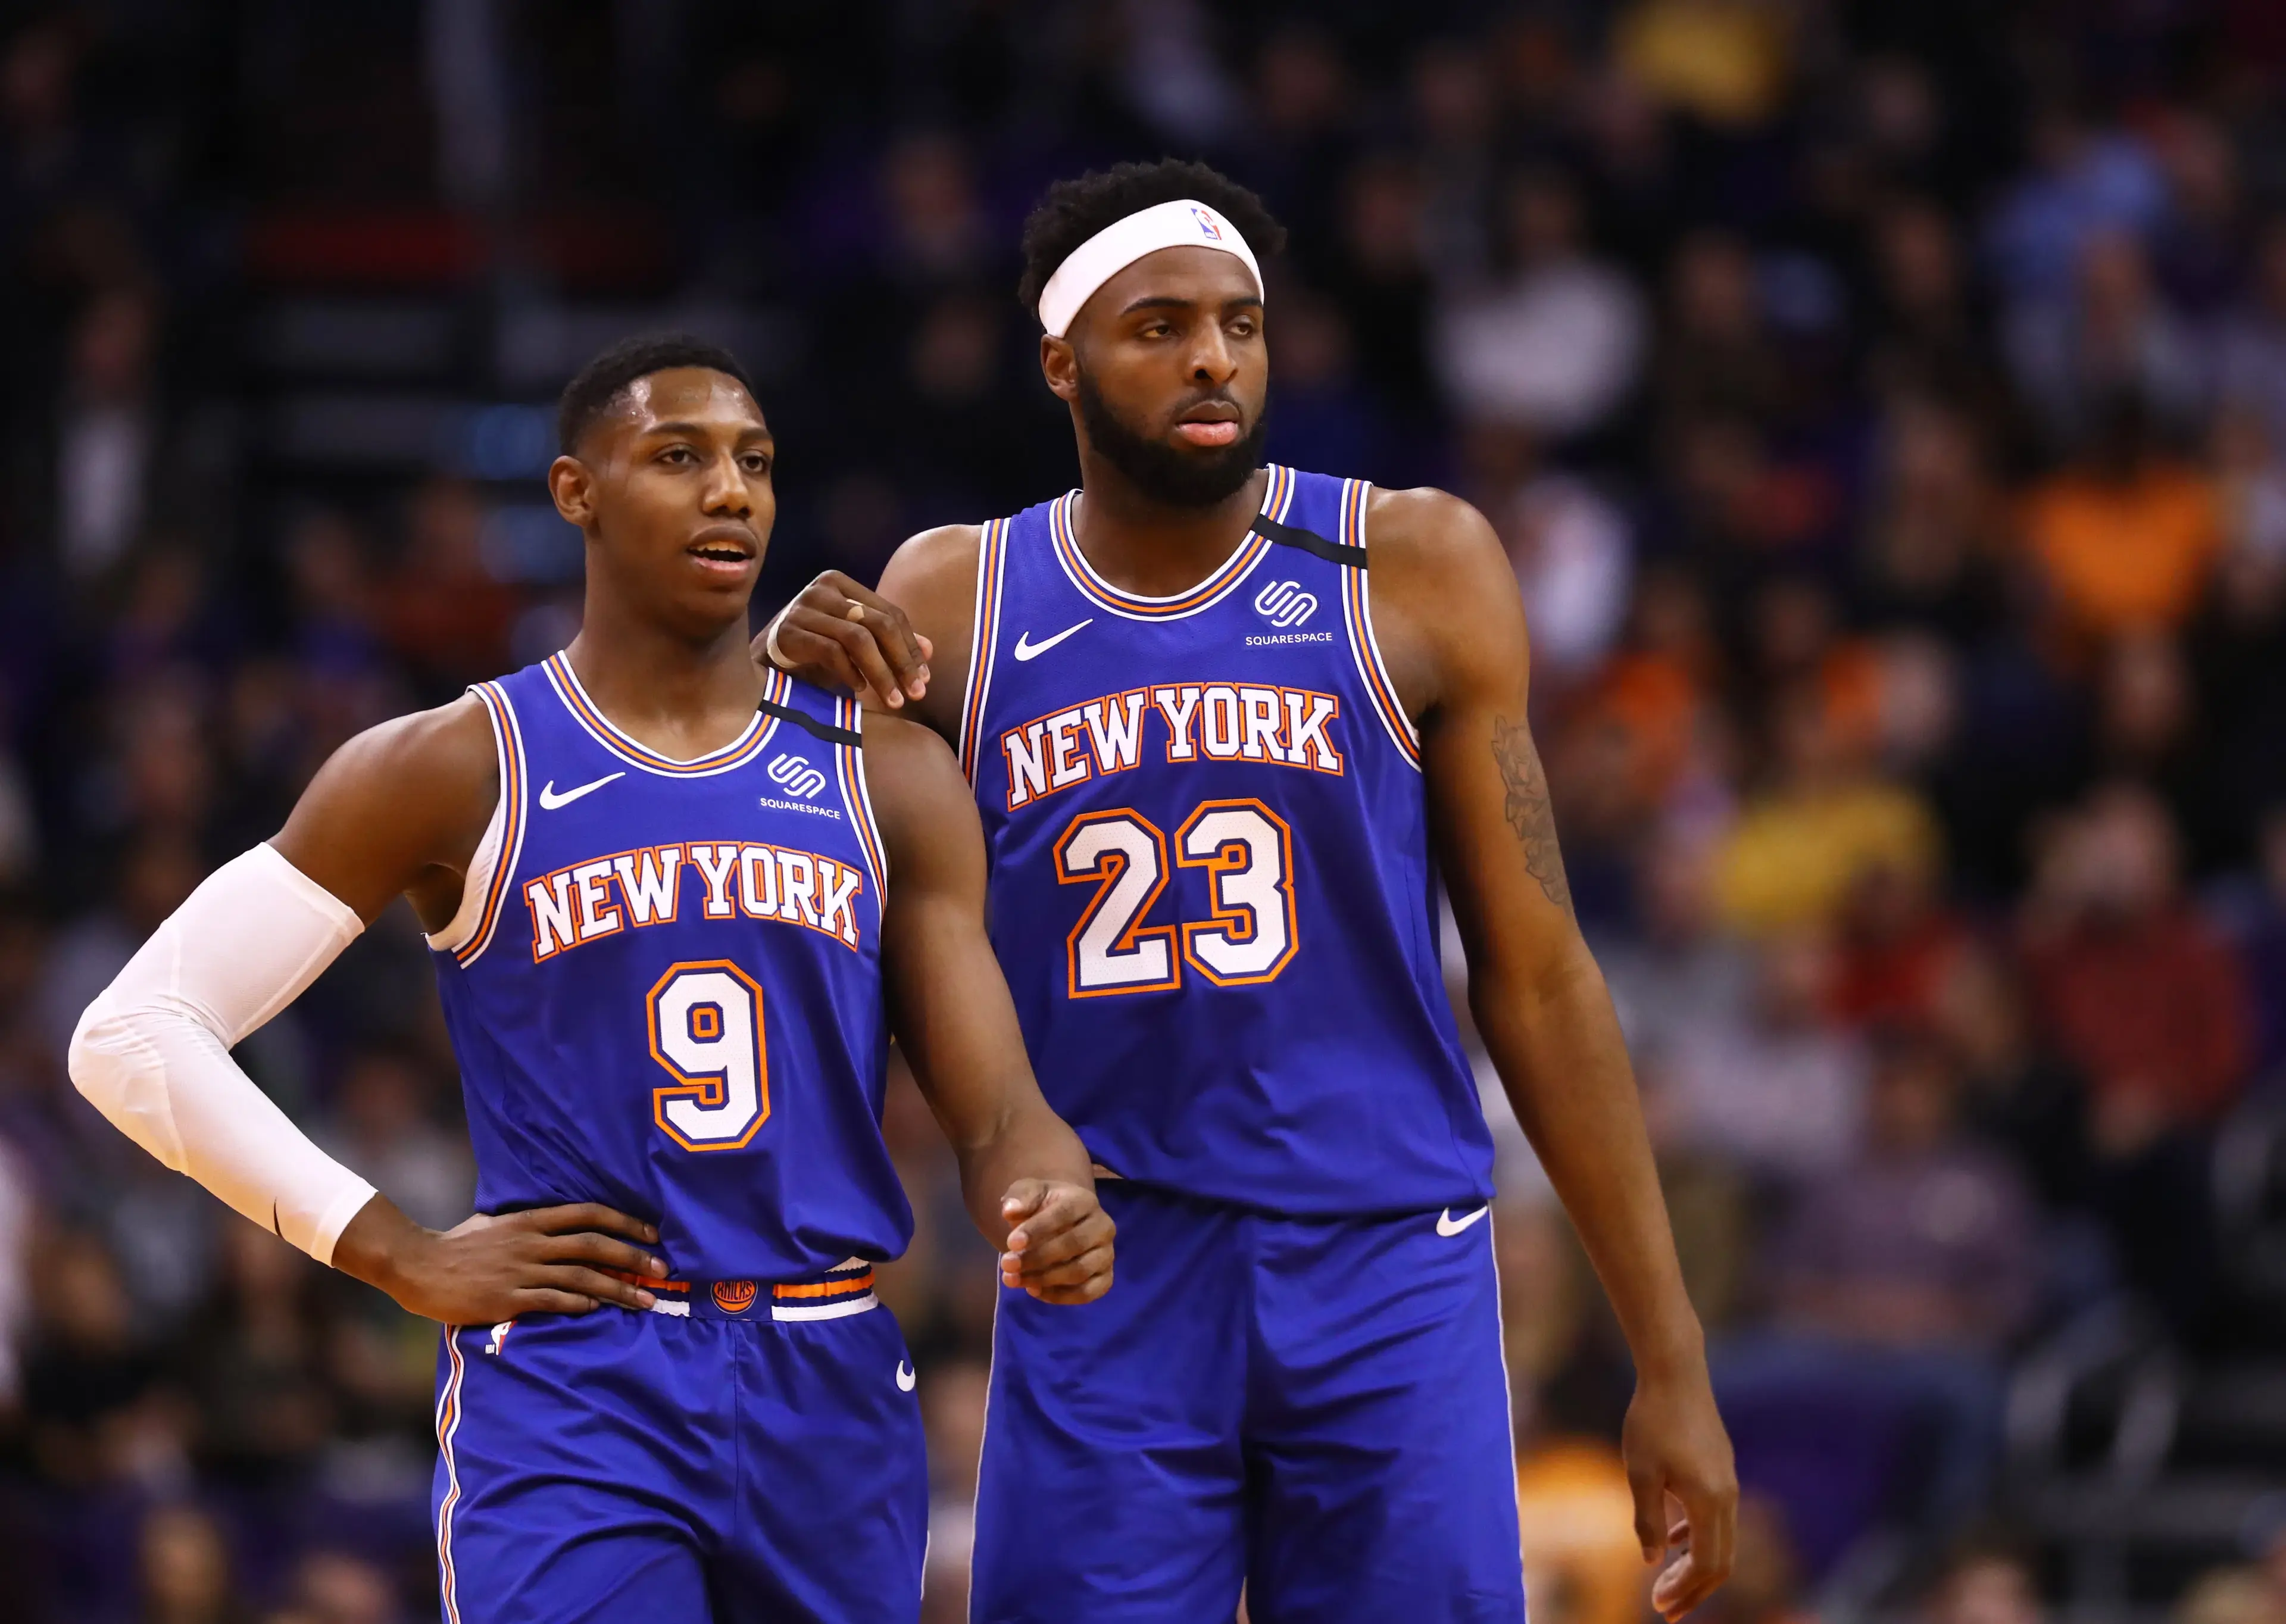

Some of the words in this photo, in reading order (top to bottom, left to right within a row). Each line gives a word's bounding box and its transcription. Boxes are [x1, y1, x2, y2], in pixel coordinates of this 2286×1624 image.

[1245, 632, 1332, 646] SQUARESPACE
[1001, 685, 1149, 811] NEW
[1151, 682, 1344, 776] YORK
[760, 797, 841, 820] SQUARESPACE
[522, 842, 686, 964] NEW
[686, 841, 863, 952] YORK
[1053, 798, 1299, 999] 23
[646, 958, 770, 1152] 9
[717, 1281, 752, 1300] KNICKS
